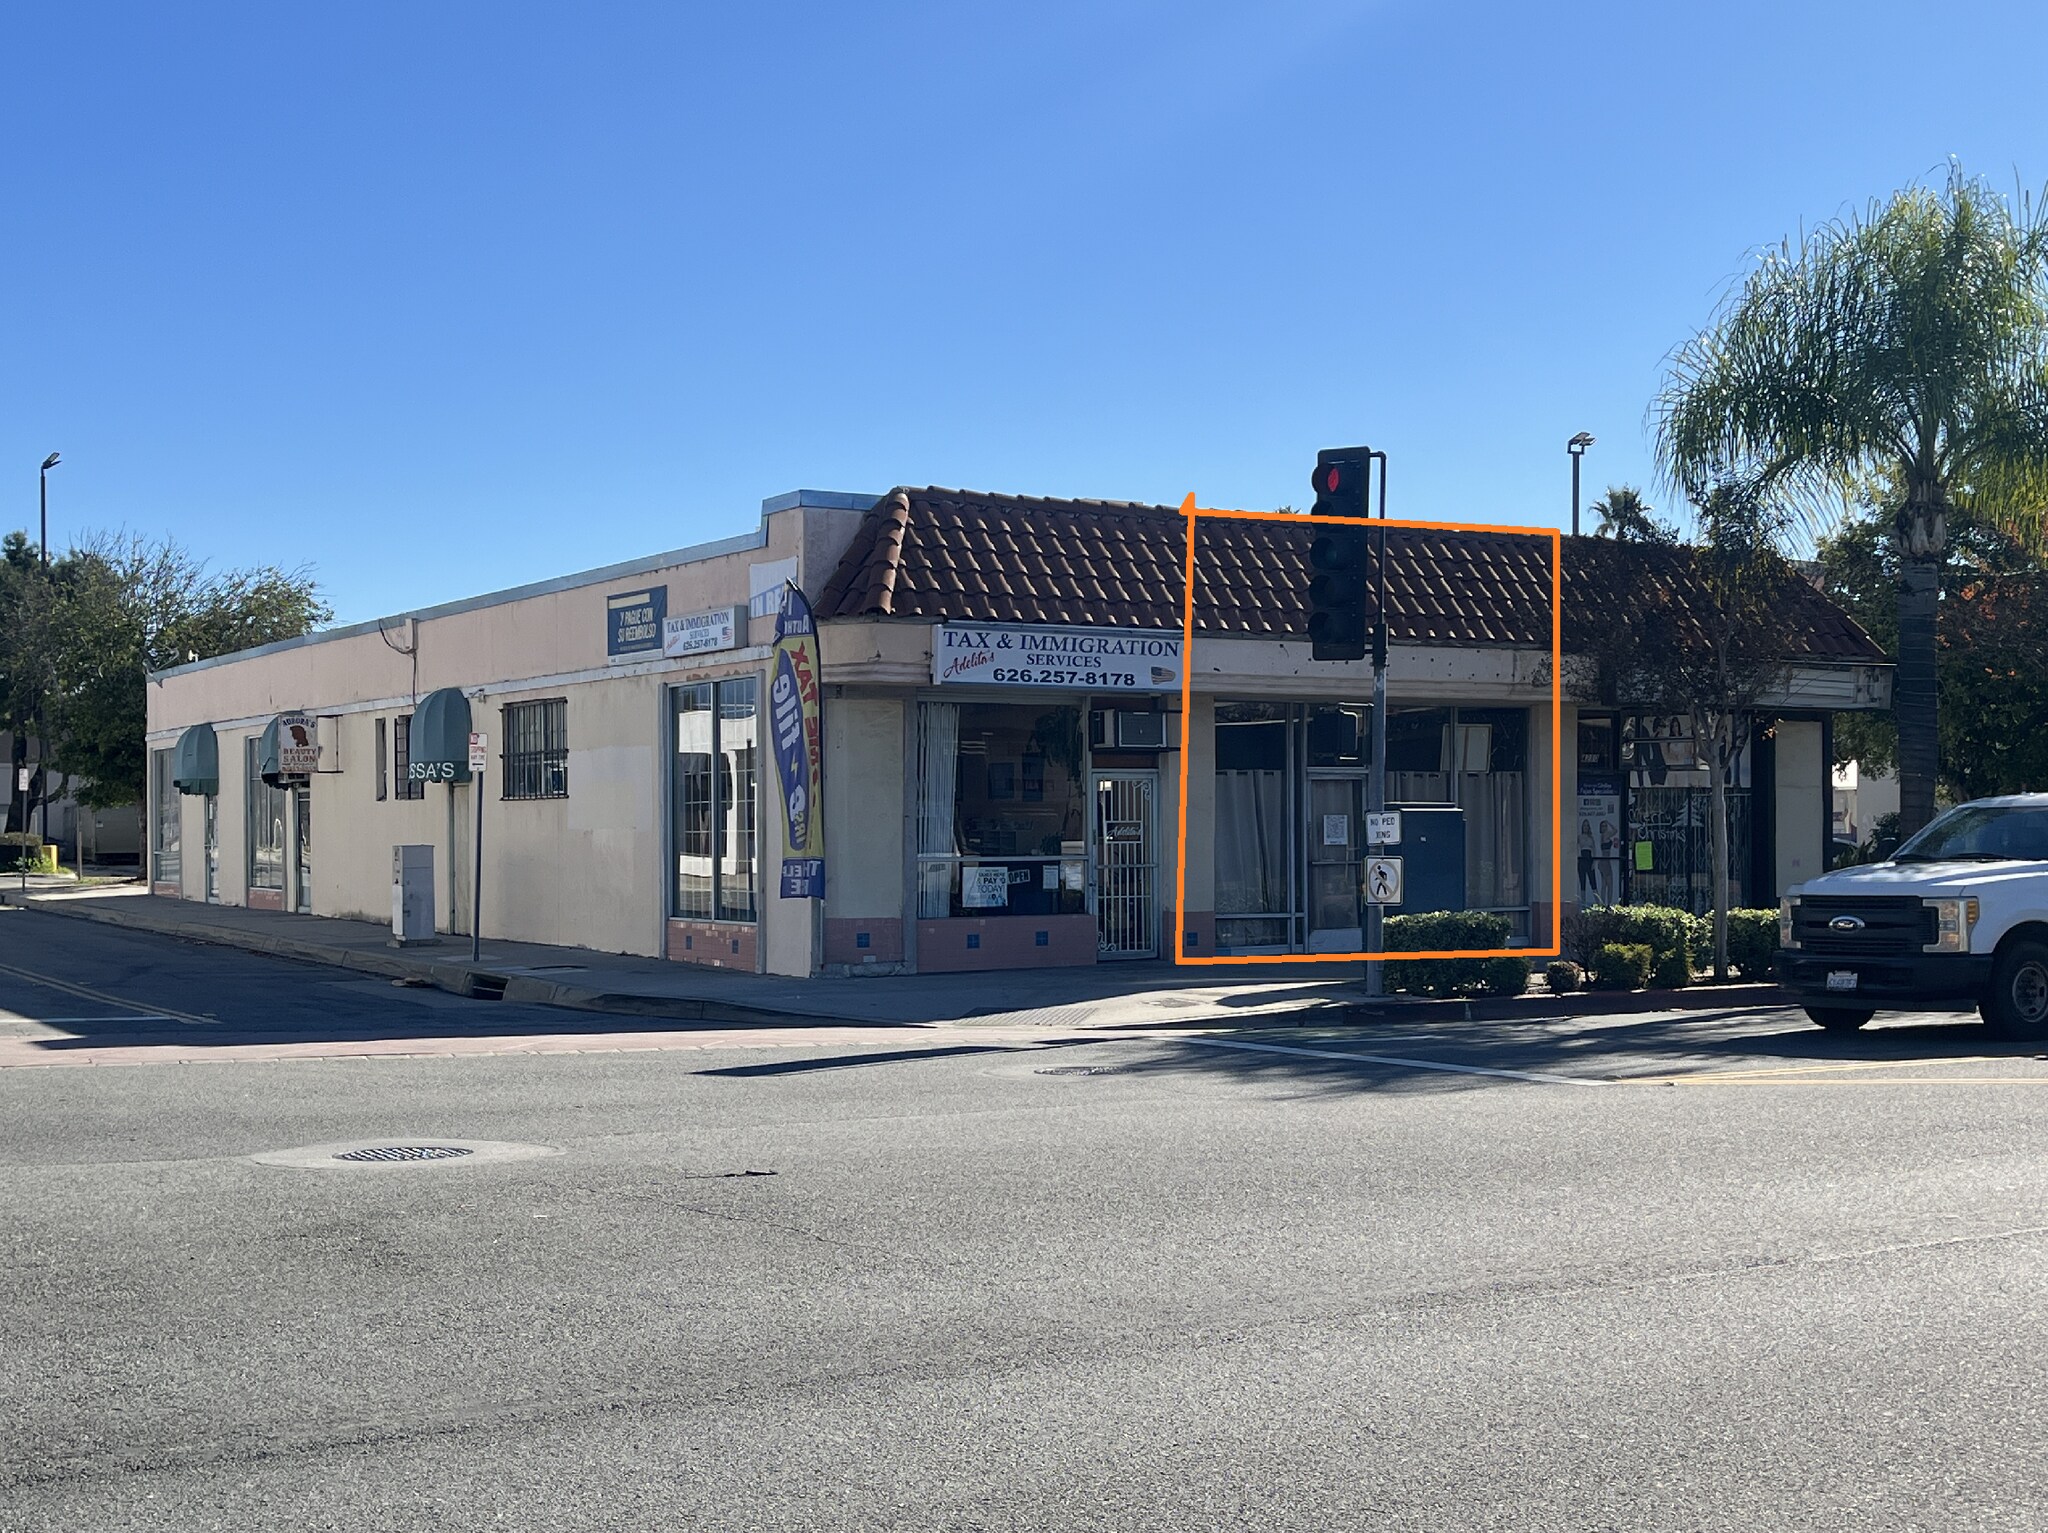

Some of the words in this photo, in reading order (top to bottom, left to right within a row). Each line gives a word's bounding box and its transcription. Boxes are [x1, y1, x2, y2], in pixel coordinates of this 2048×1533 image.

[625, 609, 641, 626] PAGUE
[643, 607, 654, 623] CON
[667, 620, 679, 633] TAX
[685, 612, 730, 631] IMMIGRATION
[618, 628, 625, 643] SU
[625, 623, 657, 641] REEMBOLSO
[943, 631, 992, 649] TAX
[996, 633, 1013, 650] &
[1019, 634, 1180, 657] IMMIGRATION
[943, 651, 995, 678] Adelita's
[1026, 653, 1102, 668] SERVICES
[993, 668, 1136, 687] 626.257-8178
[283, 717, 317, 729] AURORA'S
[1370, 818, 1378, 826] NO
[1382, 817, 1395, 826] PED
[1009, 871, 1029, 883] OPEN
